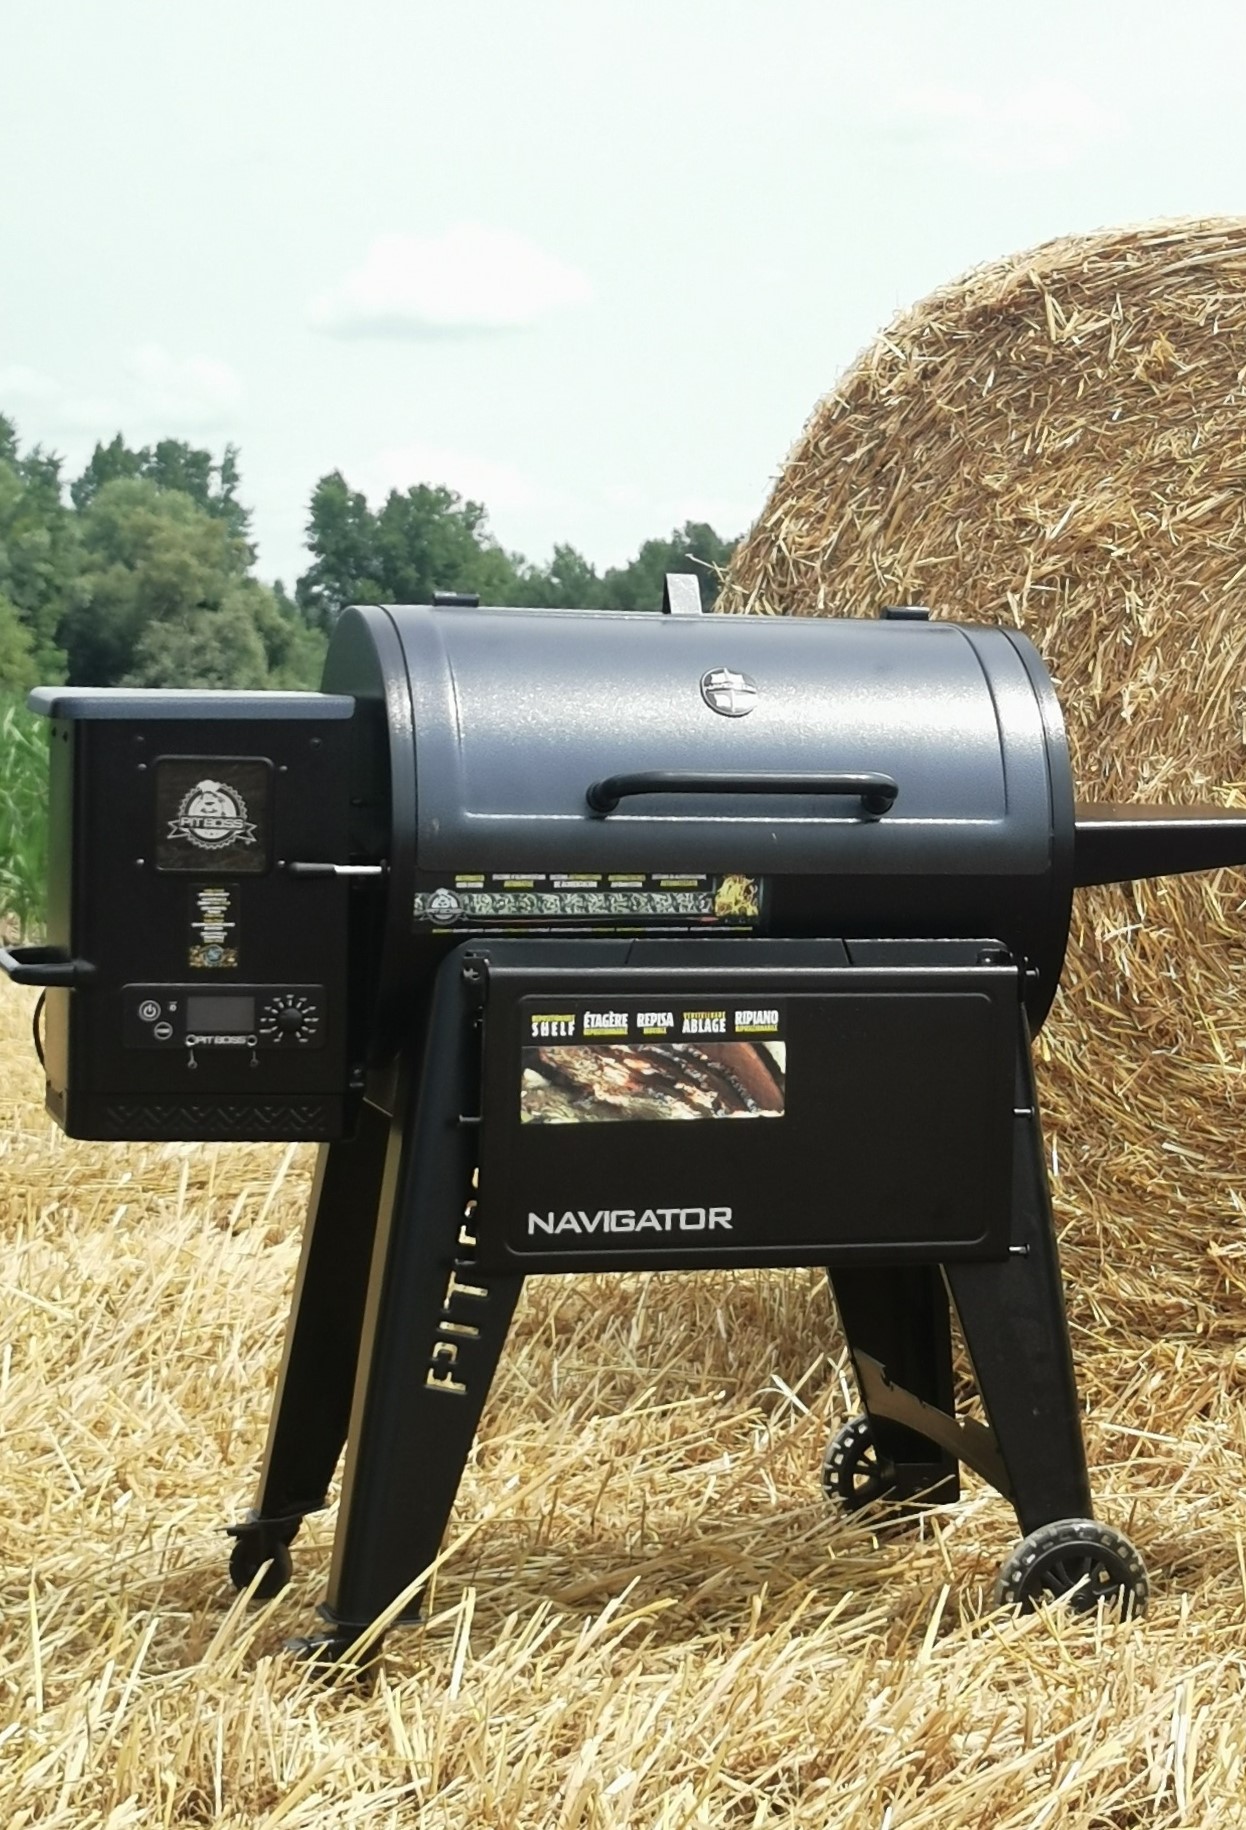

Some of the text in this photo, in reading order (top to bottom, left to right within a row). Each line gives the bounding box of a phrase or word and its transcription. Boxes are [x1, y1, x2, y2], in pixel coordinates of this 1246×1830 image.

[181, 817, 244, 829] PIT BOSS
[583, 1011, 629, 1028] ÉTAGÈRE
[637, 1012, 675, 1028] REPISA
[682, 1018, 727, 1034] ABLAGE
[735, 1010, 779, 1026] RIPIANO
[531, 1021, 576, 1037] SHELF
[214, 1035, 247, 1045] BOSS
[528, 1207, 733, 1235] NAVIGATOR
[425, 1270, 489, 1394] PIT
